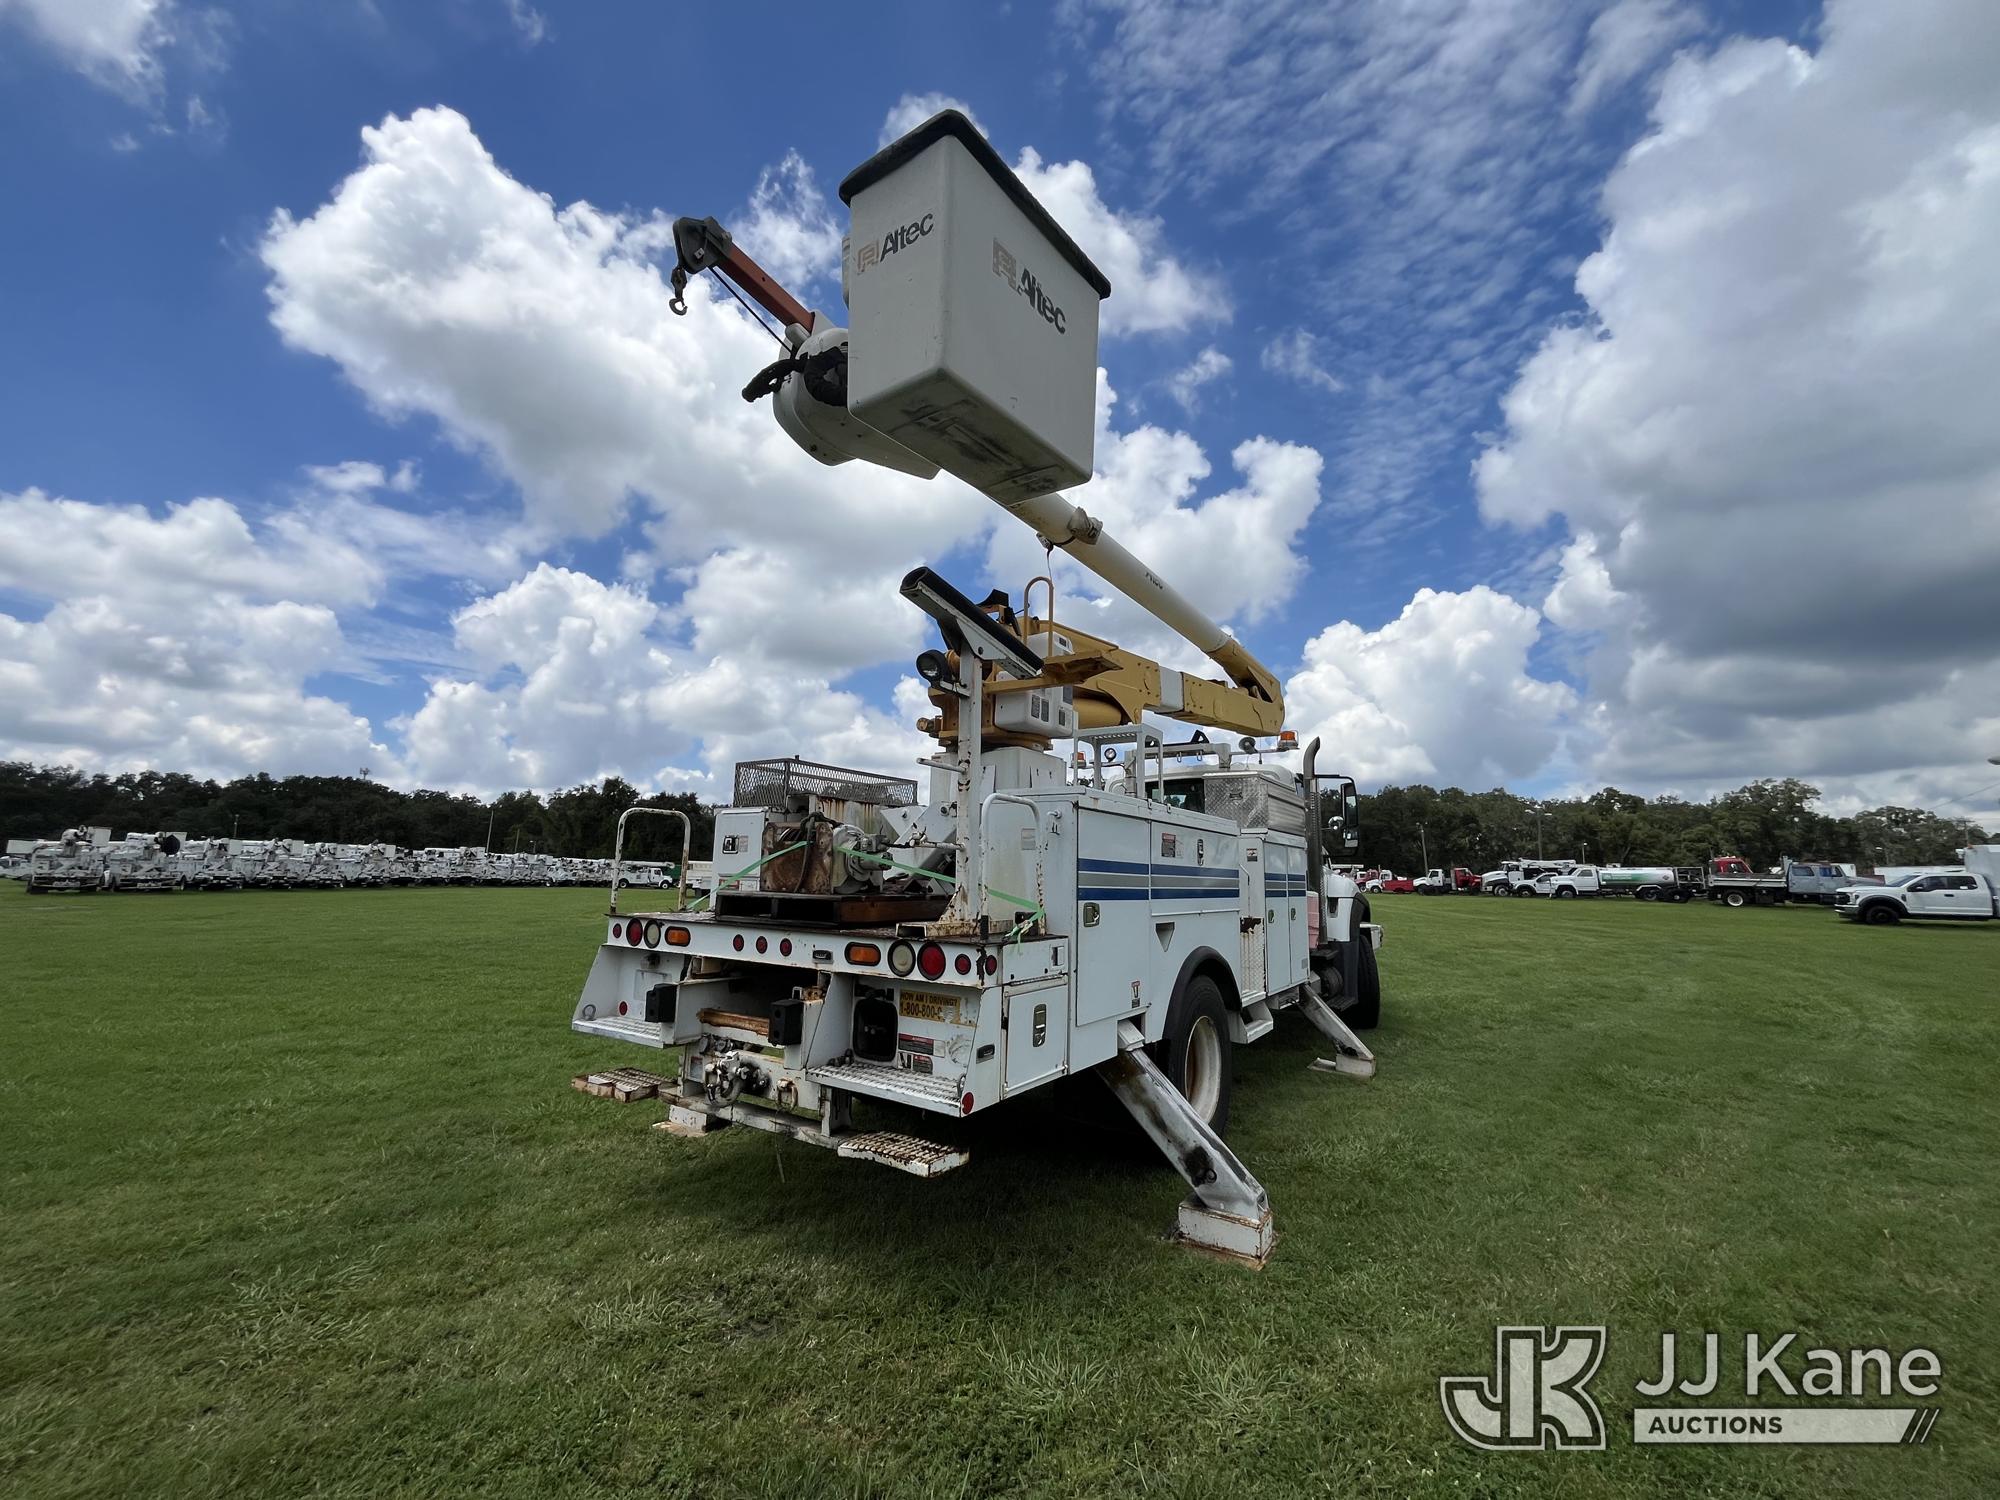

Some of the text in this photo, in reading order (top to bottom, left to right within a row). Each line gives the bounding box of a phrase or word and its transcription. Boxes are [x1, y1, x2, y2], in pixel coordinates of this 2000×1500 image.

[880, 213, 934, 263] Altec
[1018, 267, 1066, 335] Altec
[900, 991, 914, 1001] HOW
